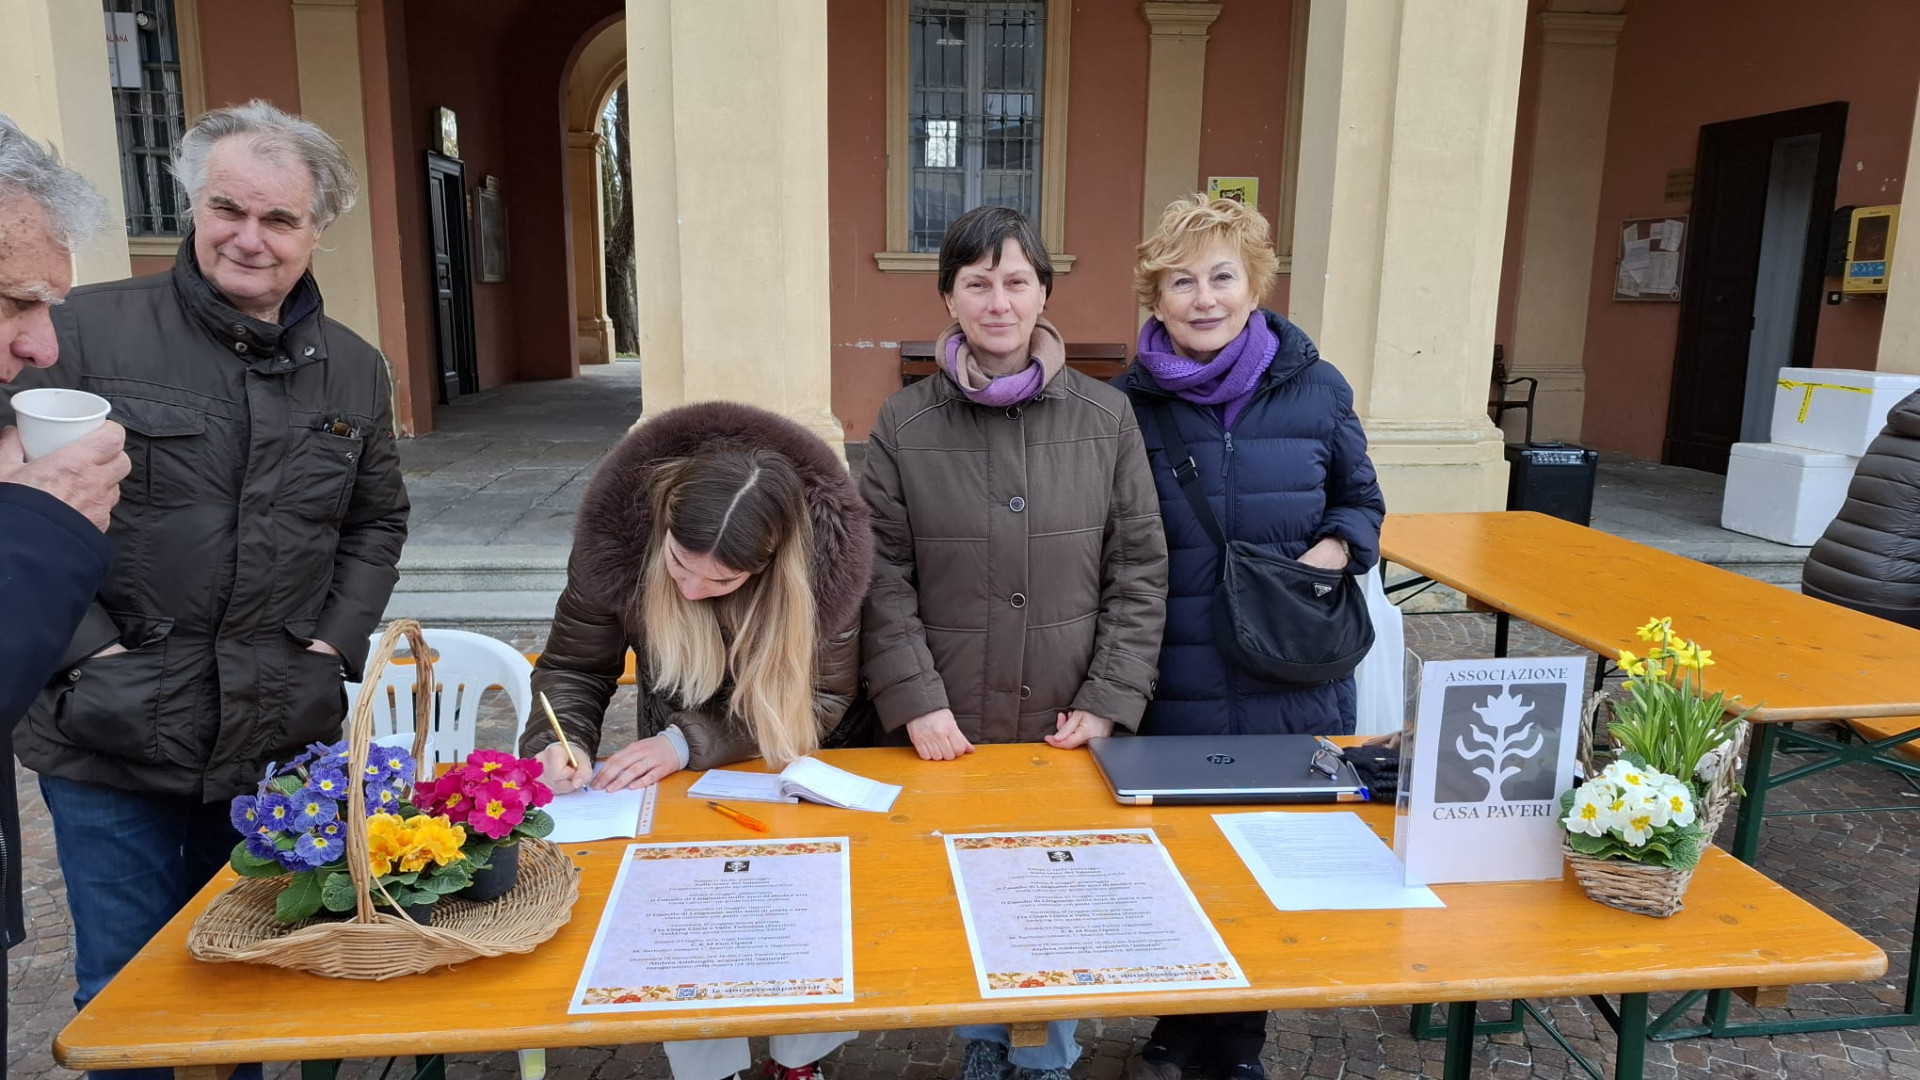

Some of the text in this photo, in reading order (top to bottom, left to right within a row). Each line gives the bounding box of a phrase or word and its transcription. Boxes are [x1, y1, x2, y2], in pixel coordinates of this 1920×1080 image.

[1445, 667, 1568, 682] ASSOCIAZIONE
[1432, 804, 1551, 821] CASA PAVERI
